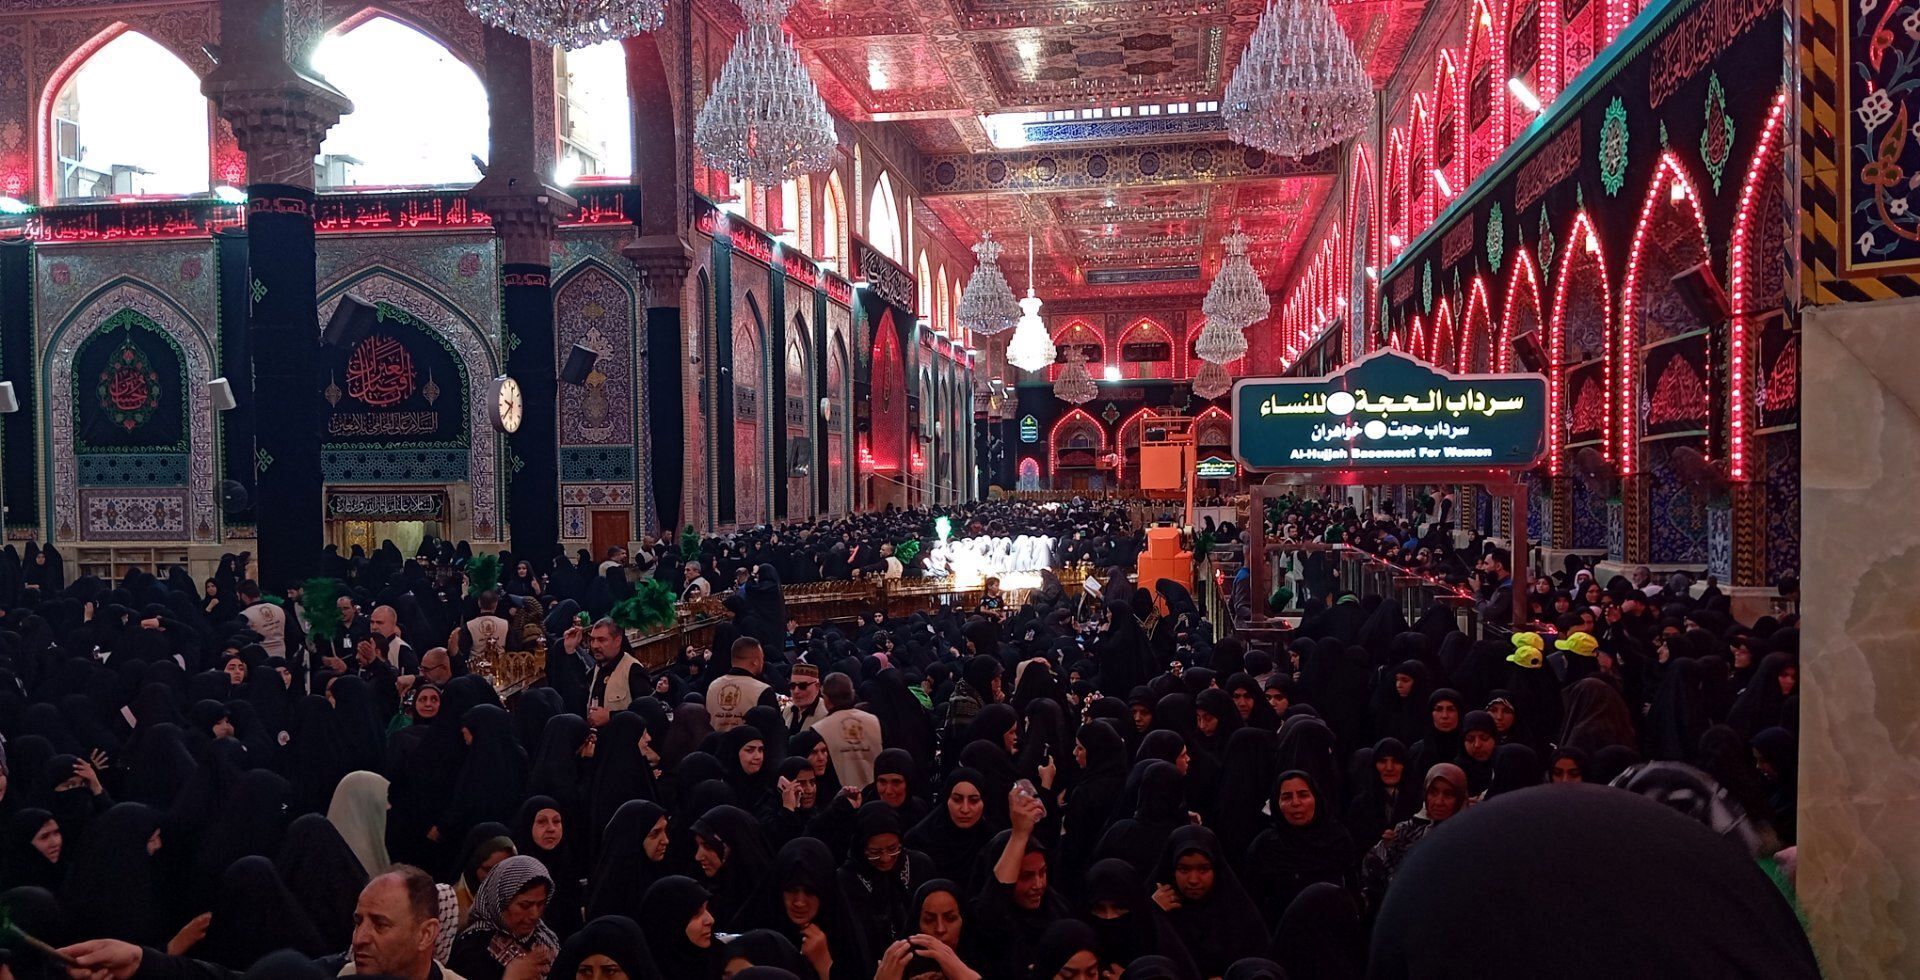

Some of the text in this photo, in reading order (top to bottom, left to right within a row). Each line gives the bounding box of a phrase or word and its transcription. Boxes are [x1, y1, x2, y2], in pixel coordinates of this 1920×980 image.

[1260, 388, 1524, 419] سرداب الحجة للنساء
[1311, 420, 1470, 442] سرداب حجت خواهران
[1290, 446, 1492, 461] Al-Hujjah Basement For Women
